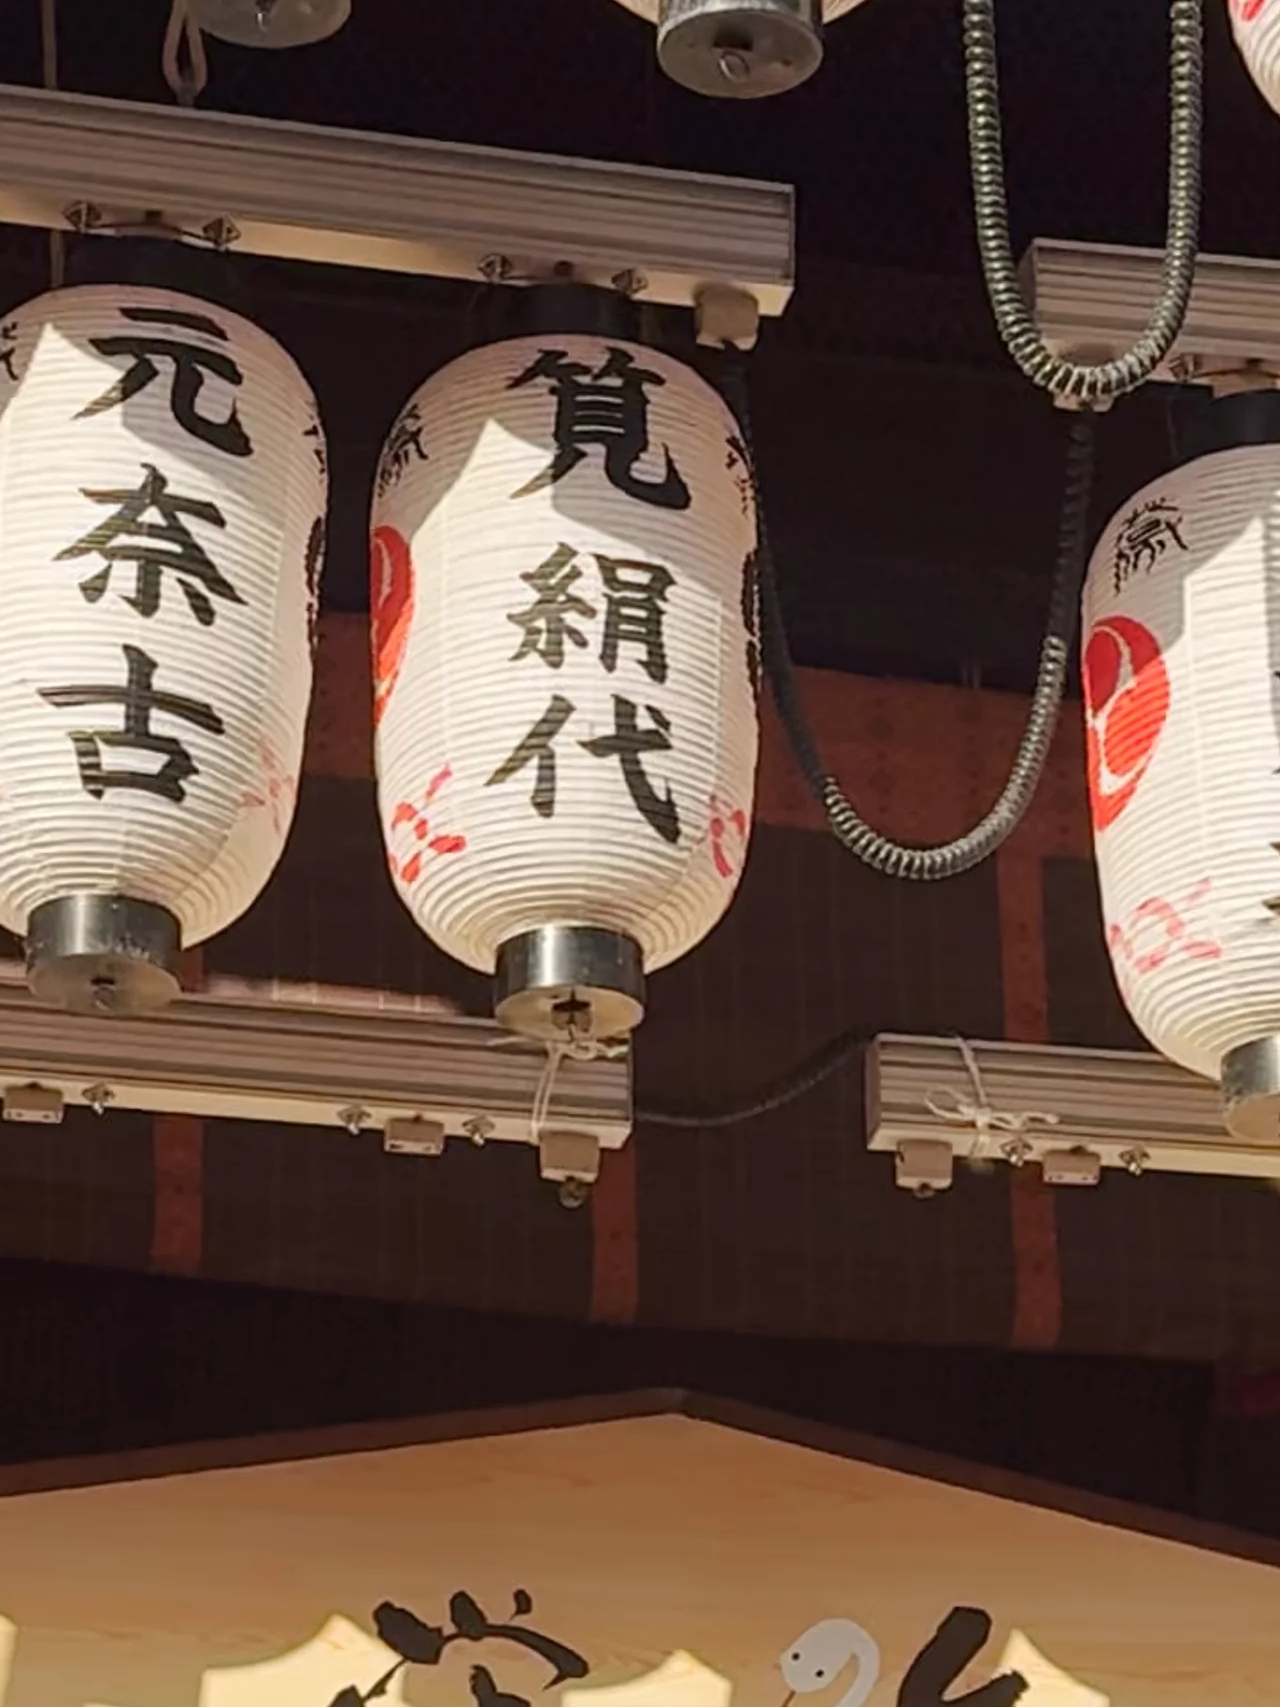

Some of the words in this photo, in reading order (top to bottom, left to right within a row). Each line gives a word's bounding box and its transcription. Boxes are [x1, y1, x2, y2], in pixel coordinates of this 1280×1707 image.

[36, 307, 254, 804] 元奈古
[483, 346, 690, 844] 筧絹代
